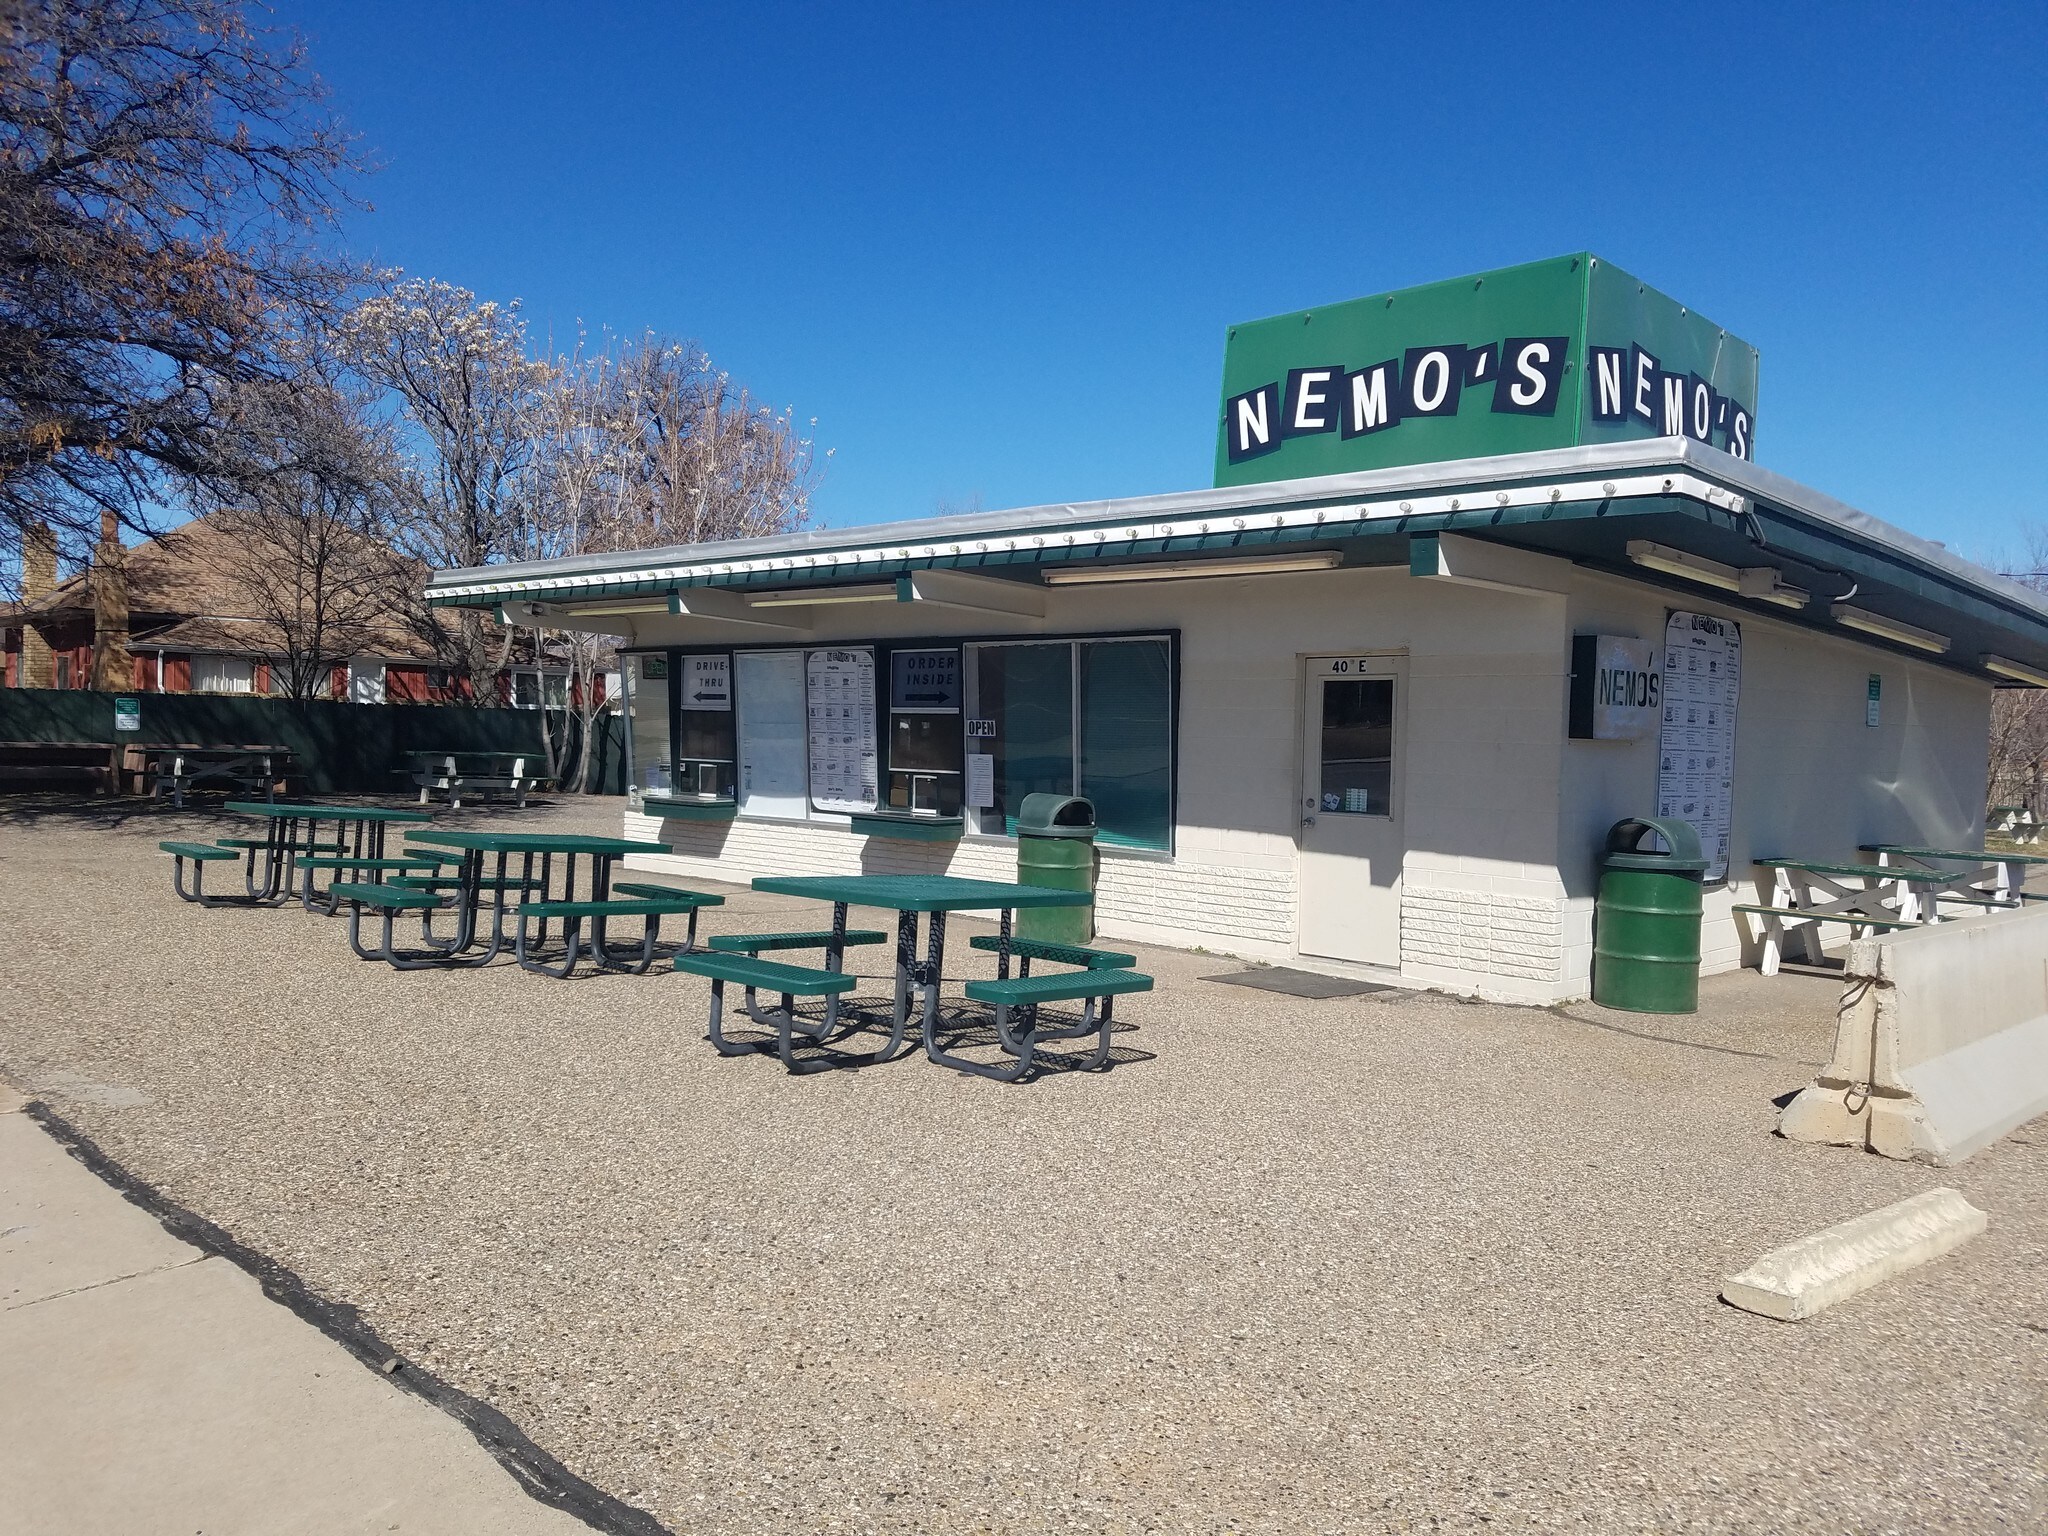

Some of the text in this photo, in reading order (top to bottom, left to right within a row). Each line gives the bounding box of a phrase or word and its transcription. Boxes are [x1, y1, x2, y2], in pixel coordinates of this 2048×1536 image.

[1237, 342, 1551, 451] NEMO'S
[1597, 351, 1749, 461] NEMO'S
[908, 658, 955, 670] ORDER
[1332, 660, 1367, 673] 40 E
[699, 678, 723, 687] THRU
[907, 674, 953, 685] INSIDE
[1600, 651, 1659, 708] NEMO'S
[968, 720, 995, 736] OPEN
